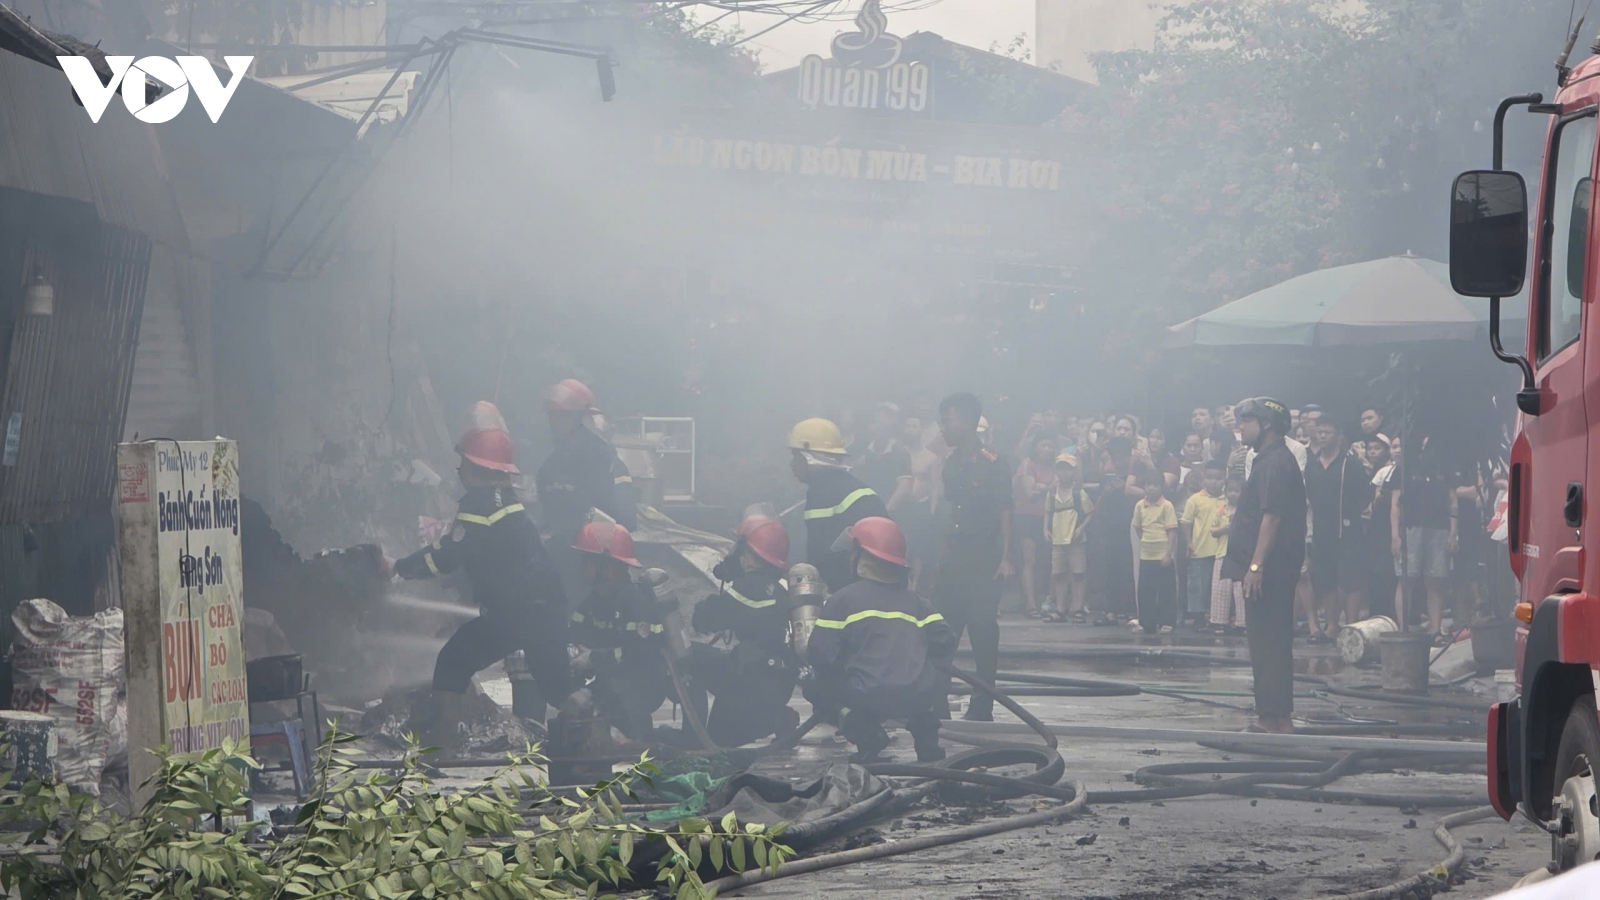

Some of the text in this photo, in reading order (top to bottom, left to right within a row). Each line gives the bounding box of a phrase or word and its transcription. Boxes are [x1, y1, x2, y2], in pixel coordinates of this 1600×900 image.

[711, 138, 795, 173] NGON
[800, 136, 862, 179] BỐN
[953, 155, 1002, 187] BIA
[199, 451, 209, 470] 12
[159, 490, 186, 532] Bánh
[205, 545, 222, 586] Sơn
[209, 594, 235, 629] CHẢ
[164, 603, 202, 703] BÚN
[210, 636, 226, 667] BÒ
